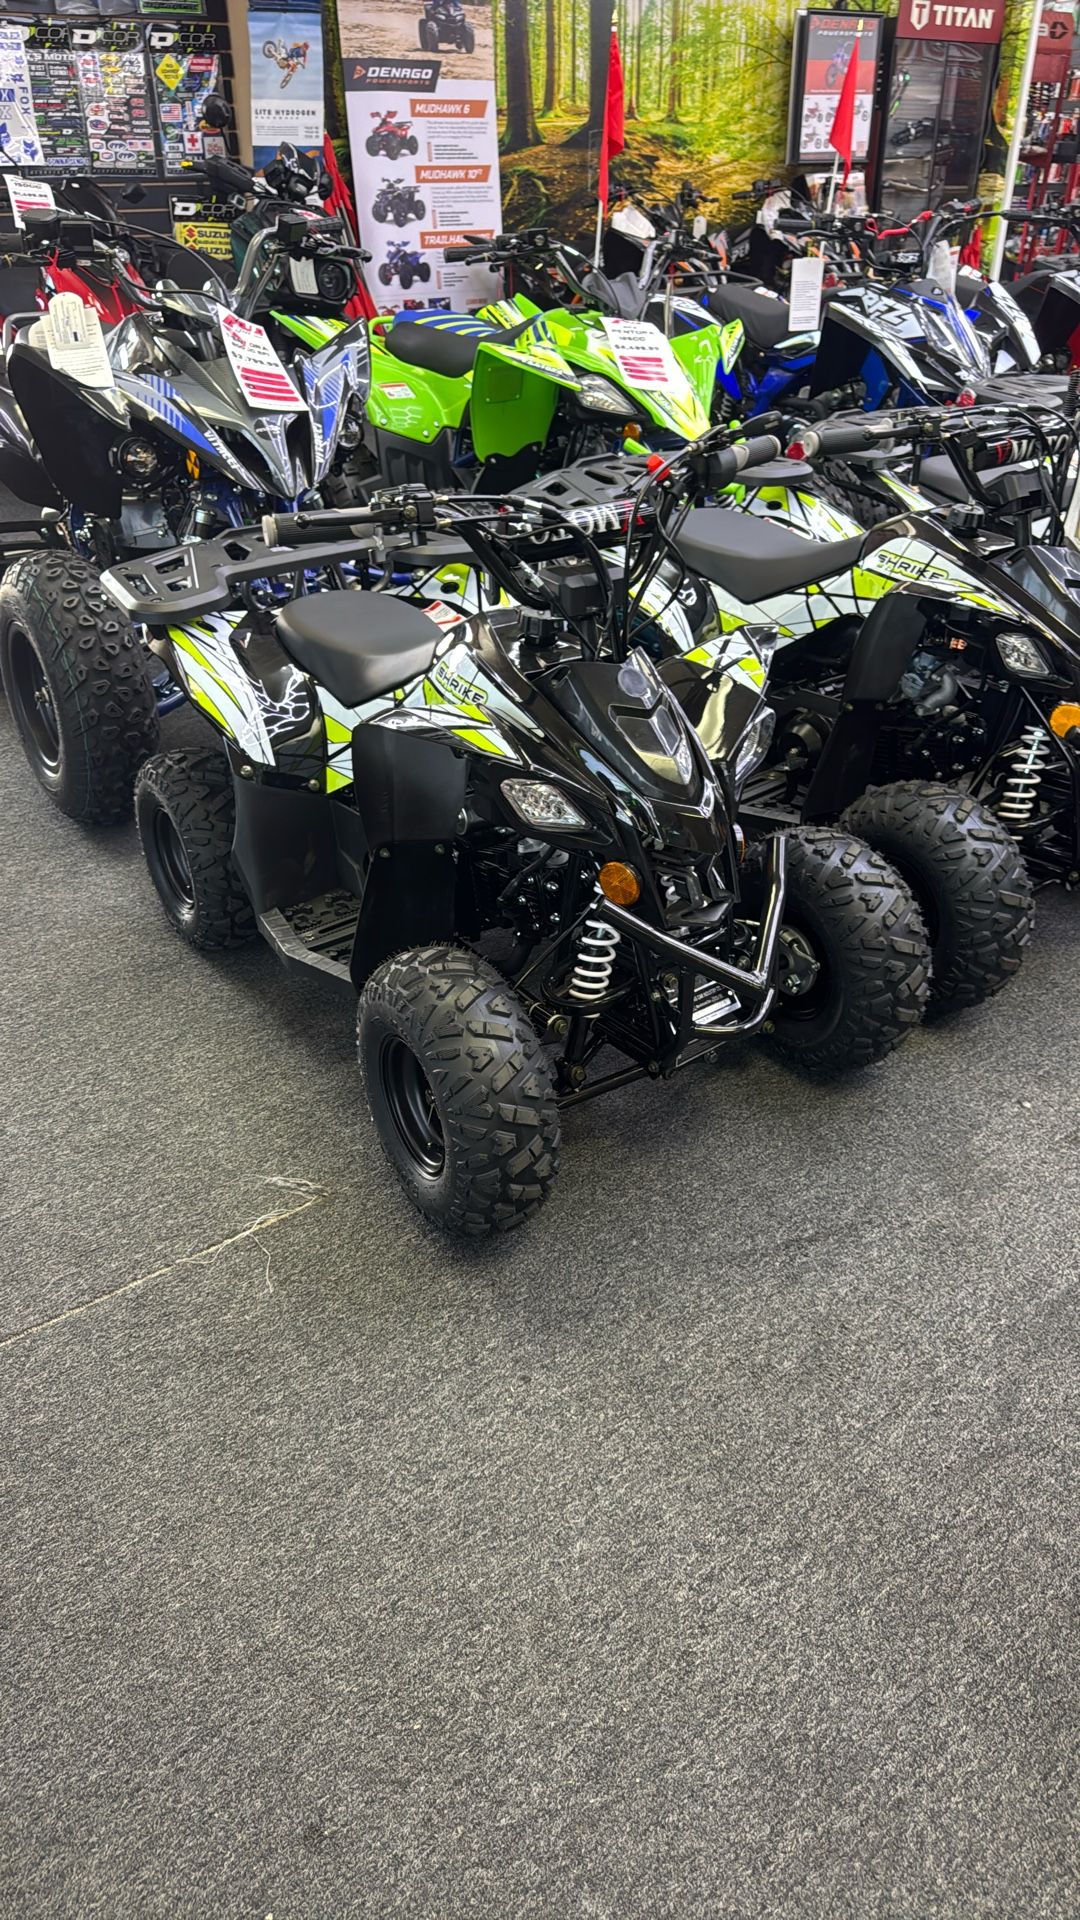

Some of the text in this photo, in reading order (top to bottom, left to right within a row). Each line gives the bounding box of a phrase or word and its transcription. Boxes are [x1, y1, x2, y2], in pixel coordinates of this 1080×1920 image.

[933, 4, 996, 29] TITAN
[367, 66, 433, 79] DENAGO
[254, 108, 317, 117] LITE HYDROGEN
[415, 103, 462, 114] MUDHAWK
[420, 169, 465, 180] MUDHAWK
[203, 429, 240, 470] VITACCI
[877, 553, 945, 581] SHRIKE
[437, 665, 485, 704] SHRIKE
